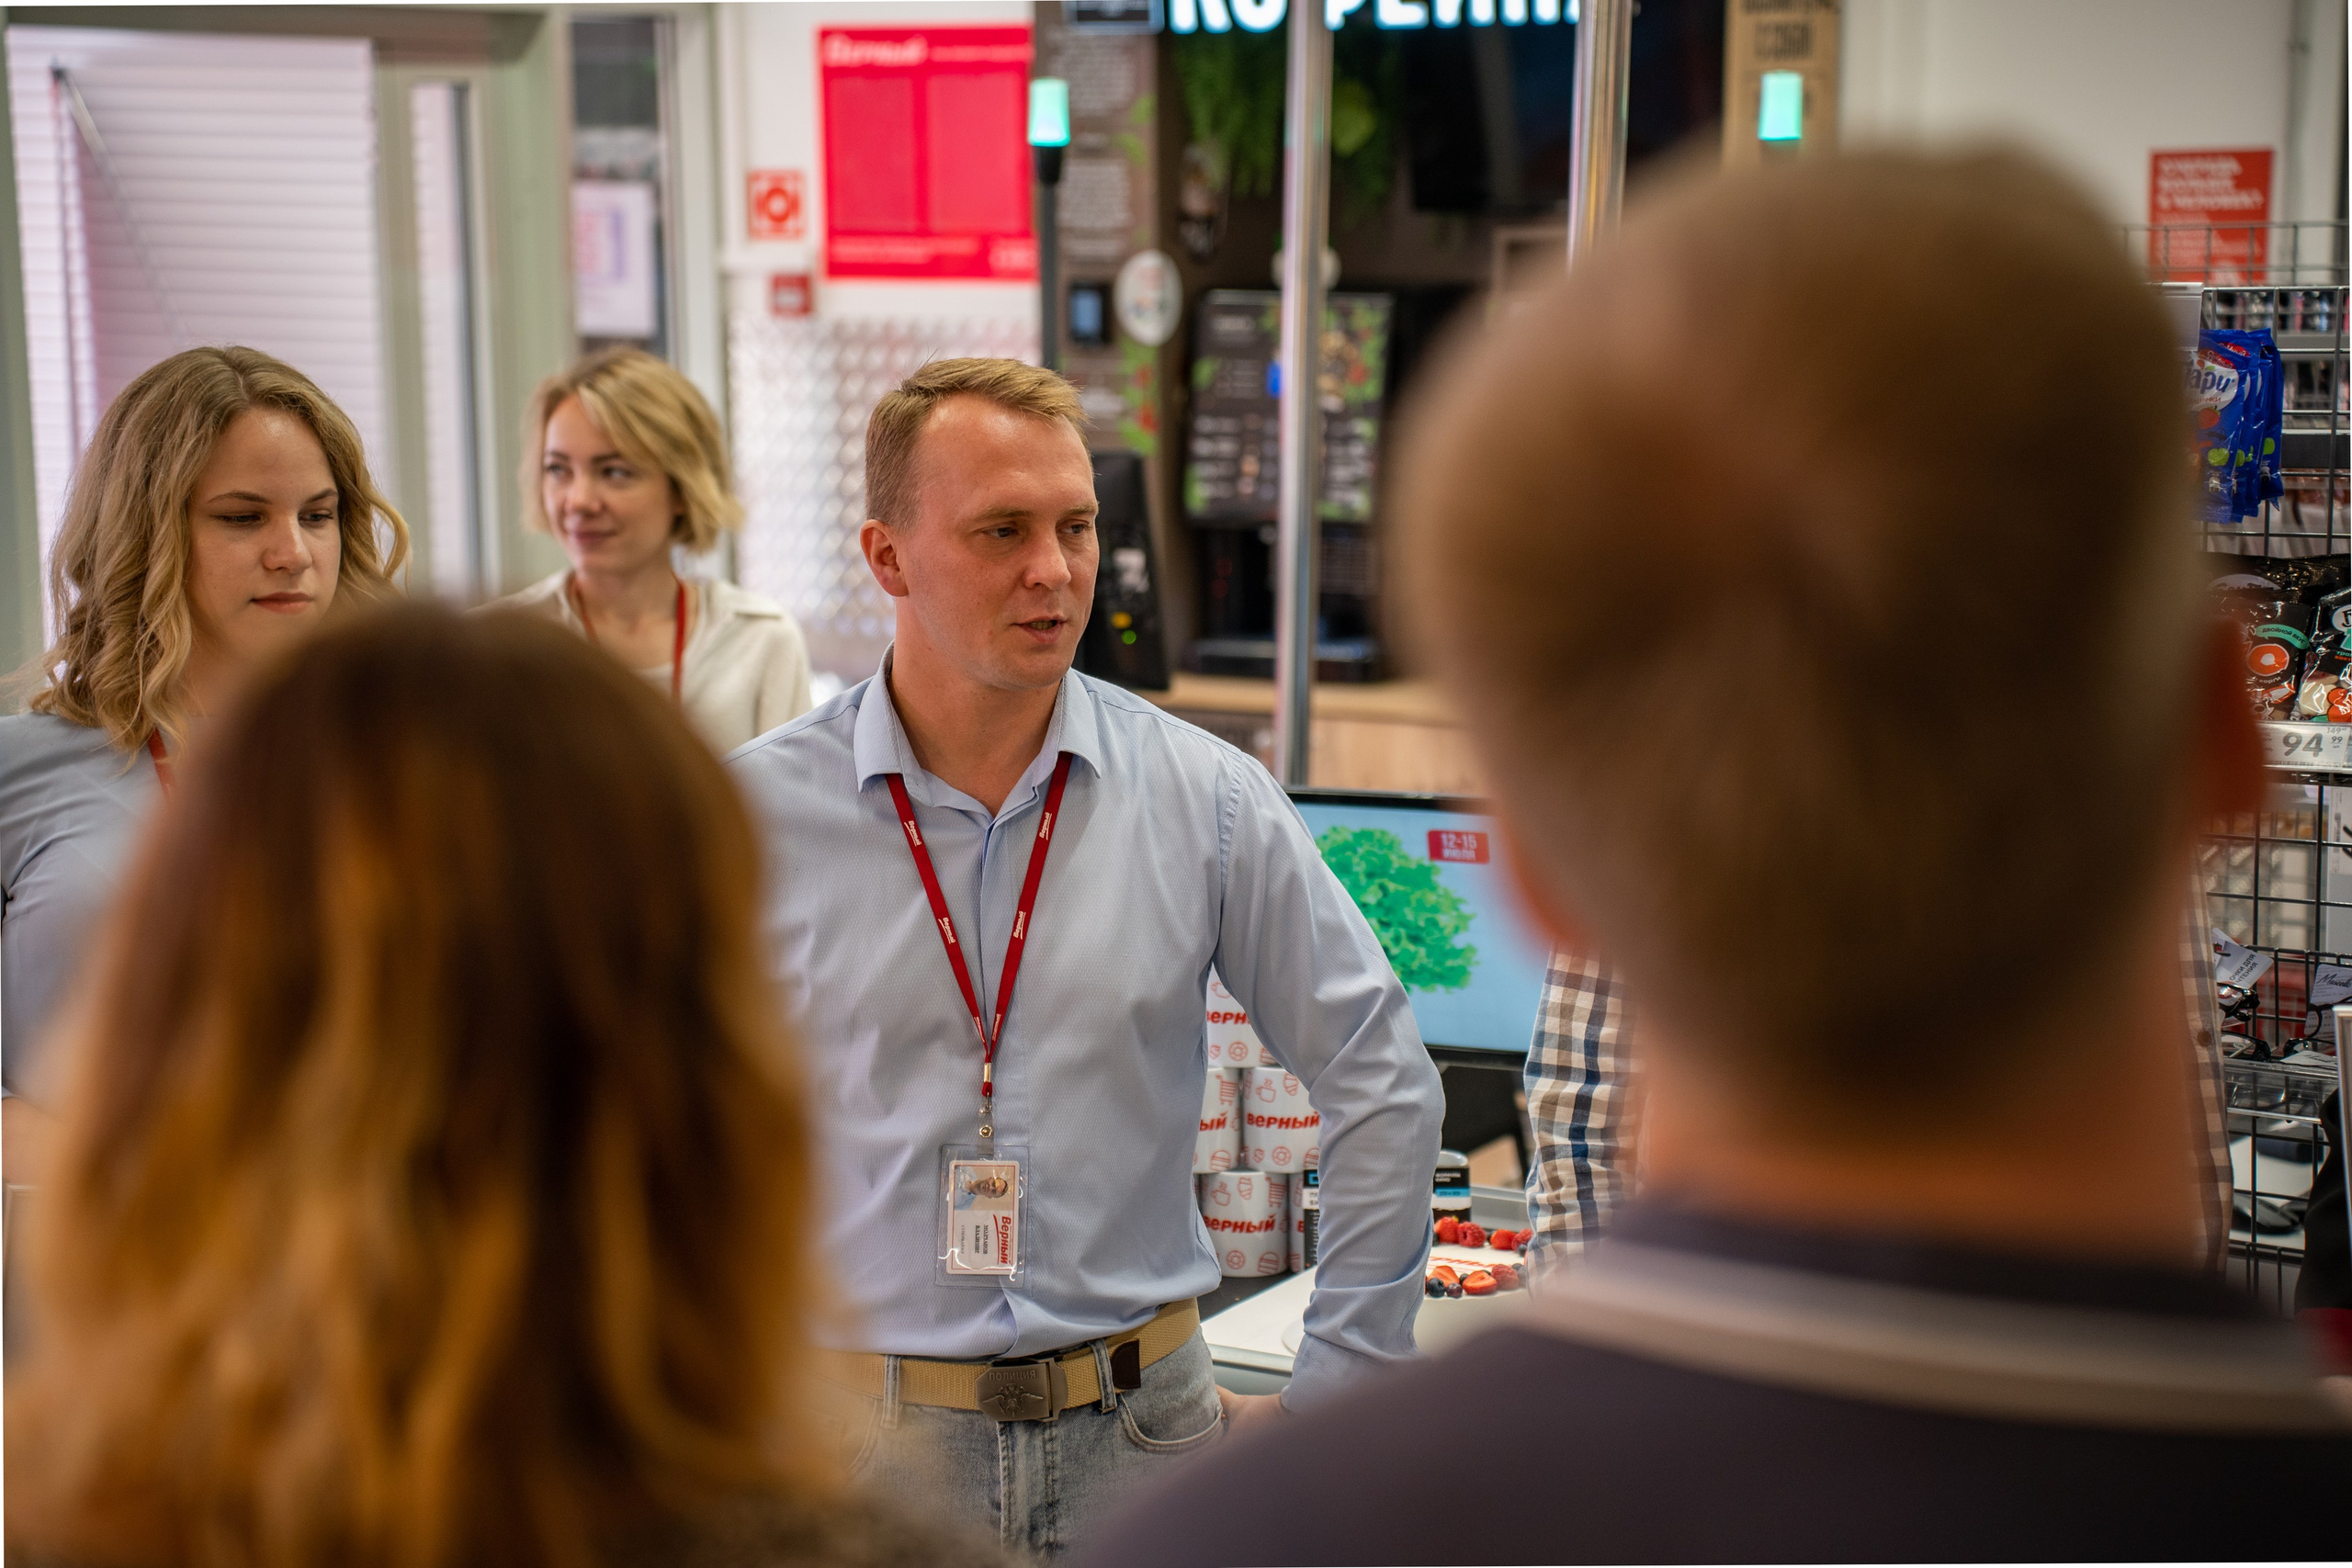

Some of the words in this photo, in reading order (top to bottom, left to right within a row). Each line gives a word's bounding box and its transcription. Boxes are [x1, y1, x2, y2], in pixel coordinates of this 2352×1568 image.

[2190, 369, 2231, 394] ари
[2282, 732, 2324, 758] 94
[1441, 833, 1477, 849] 12-15
[2229, 965, 2245, 981] ОЧКИ
[2244, 953, 2256, 967] ДЛЯ
[2235, 962, 2258, 984] ЧТЕНИЯ
[999, 1215, 1012, 1264] Верный
[989, 1370, 1036, 1381] ПОЛИЦИЯ
